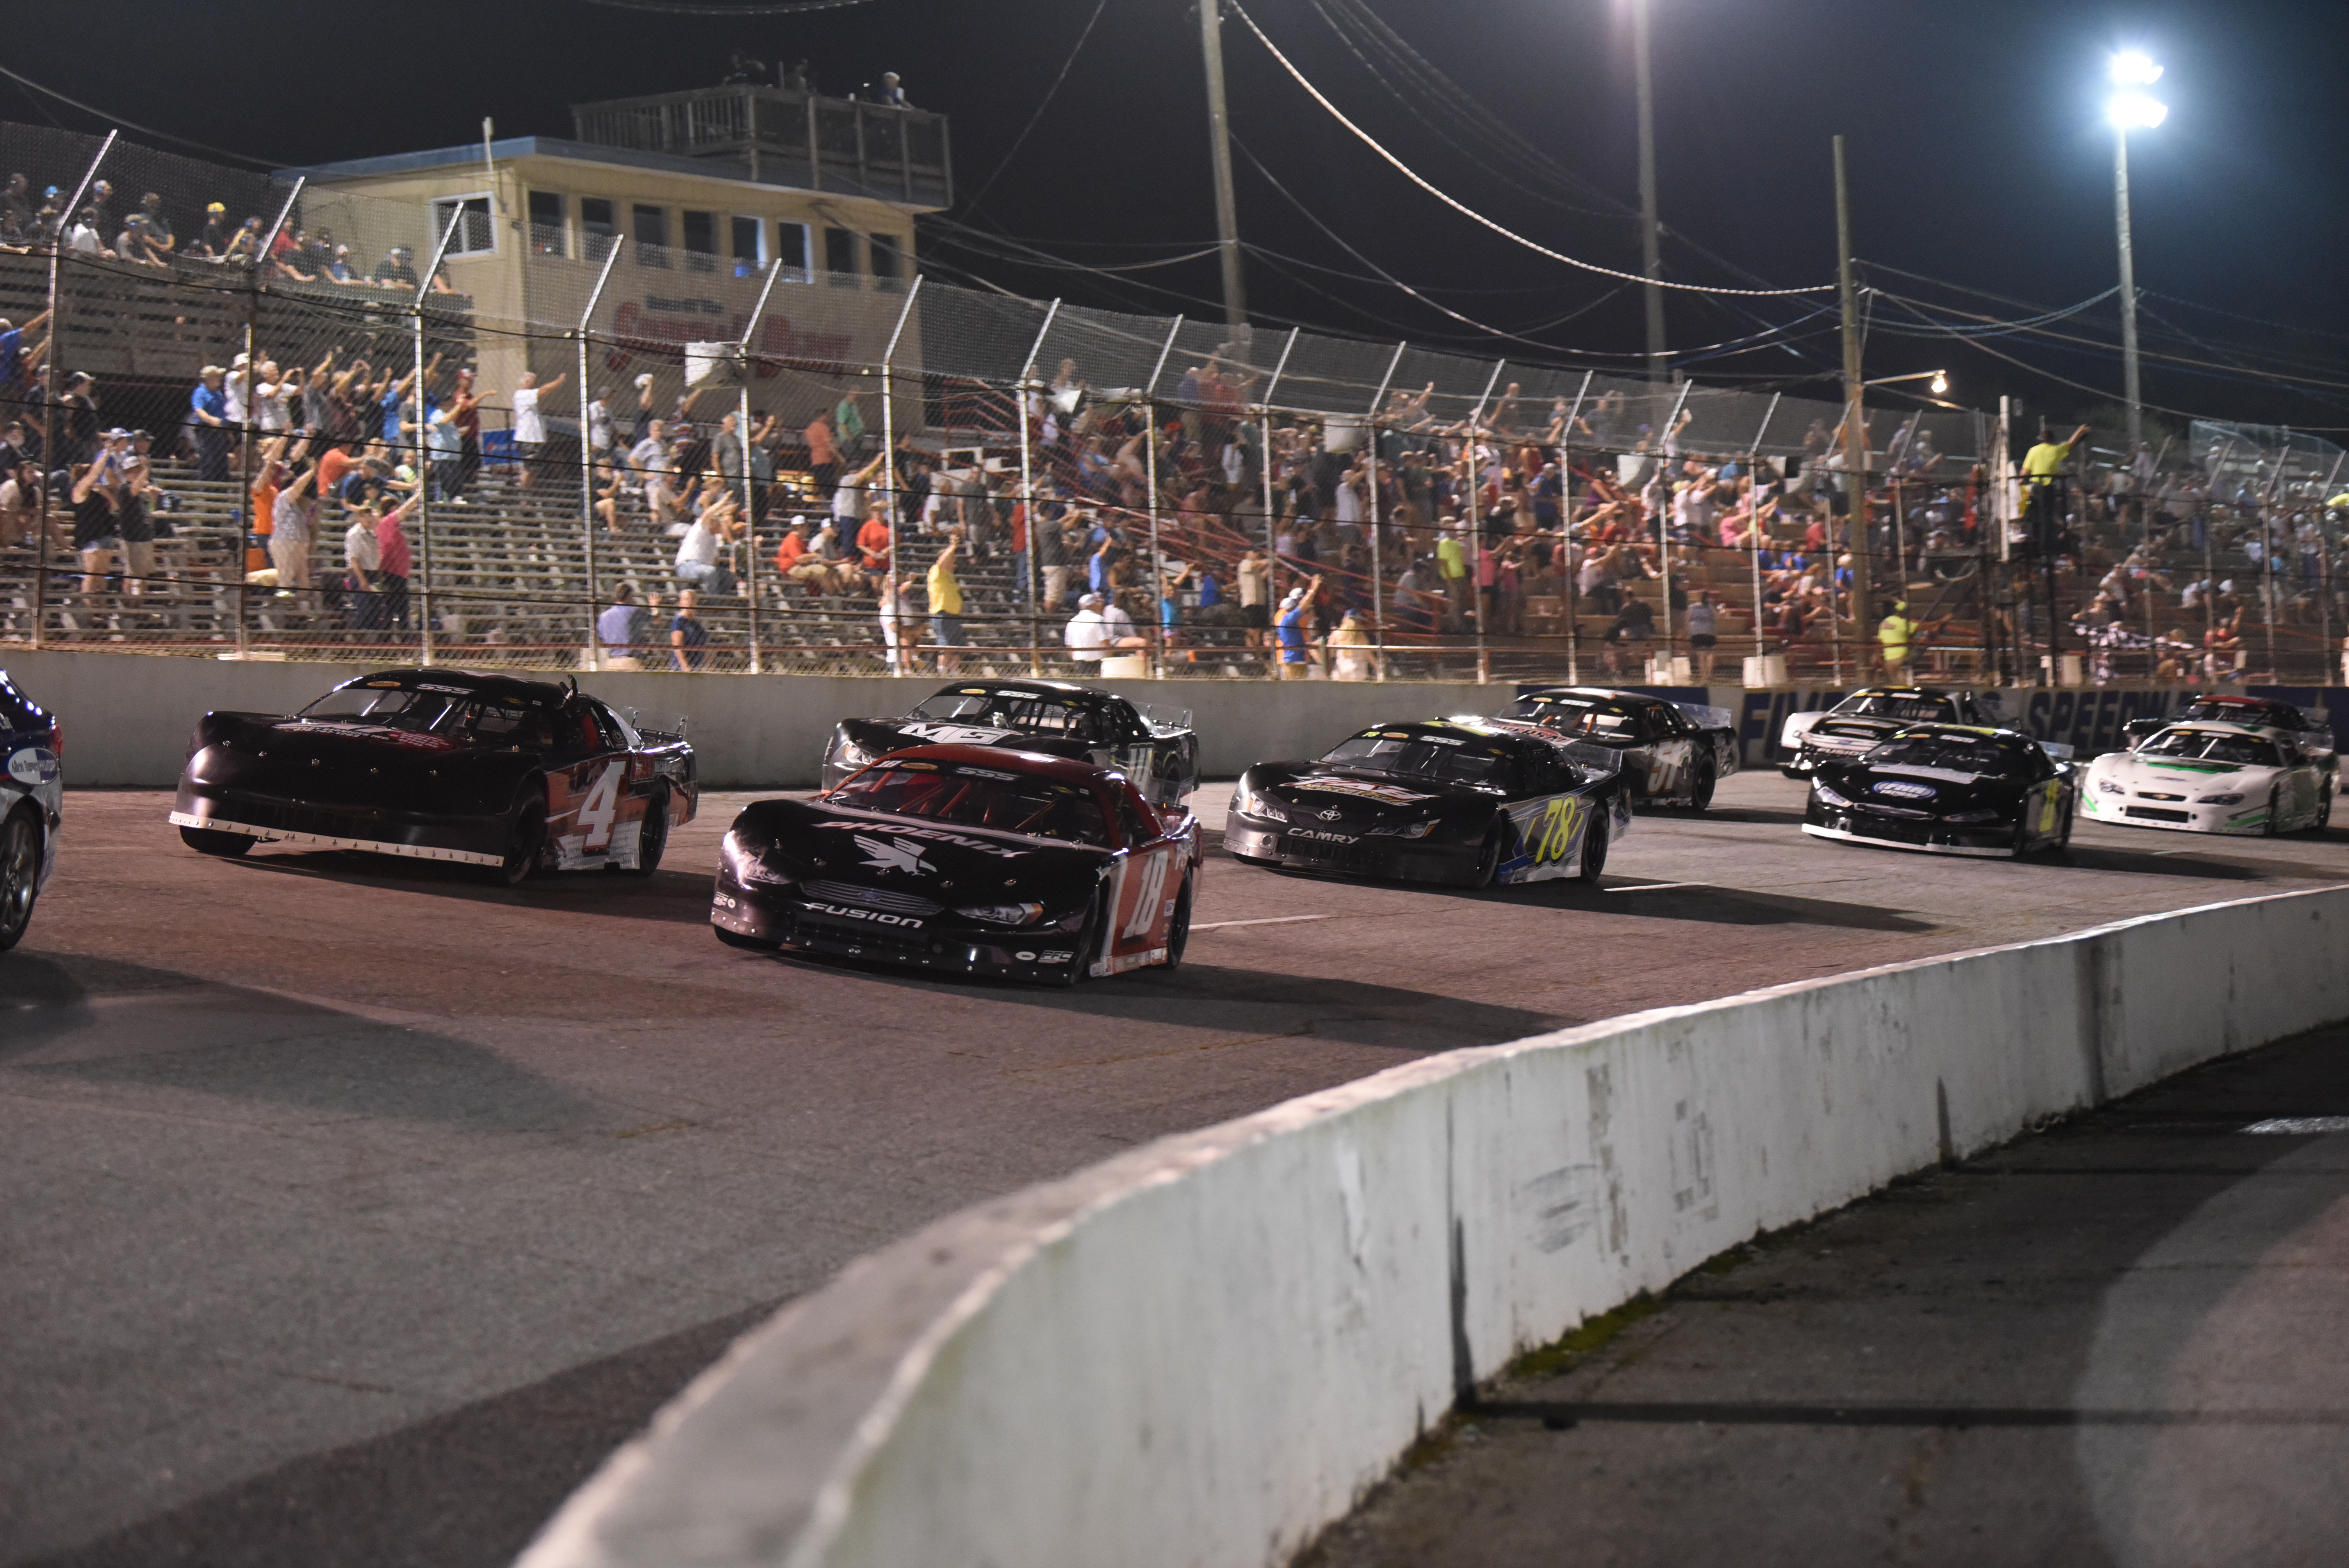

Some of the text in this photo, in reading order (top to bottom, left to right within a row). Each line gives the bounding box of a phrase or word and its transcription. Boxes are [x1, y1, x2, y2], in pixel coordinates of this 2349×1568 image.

[997, 690, 1040, 698] SSS
[323, 727, 370, 736] SERVICES
[901, 723, 1009, 743] MG
[1420, 735, 1466, 745] SSS
[955, 767, 1019, 781] SSS
[577, 760, 626, 846] 4
[811, 821, 1031, 858] PHOENIX
[1287, 828, 1360, 844] CAMRY
[1534, 793, 1576, 868] 78
[1122, 851, 1169, 939] 18
[804, 902, 923, 928] FUSION
